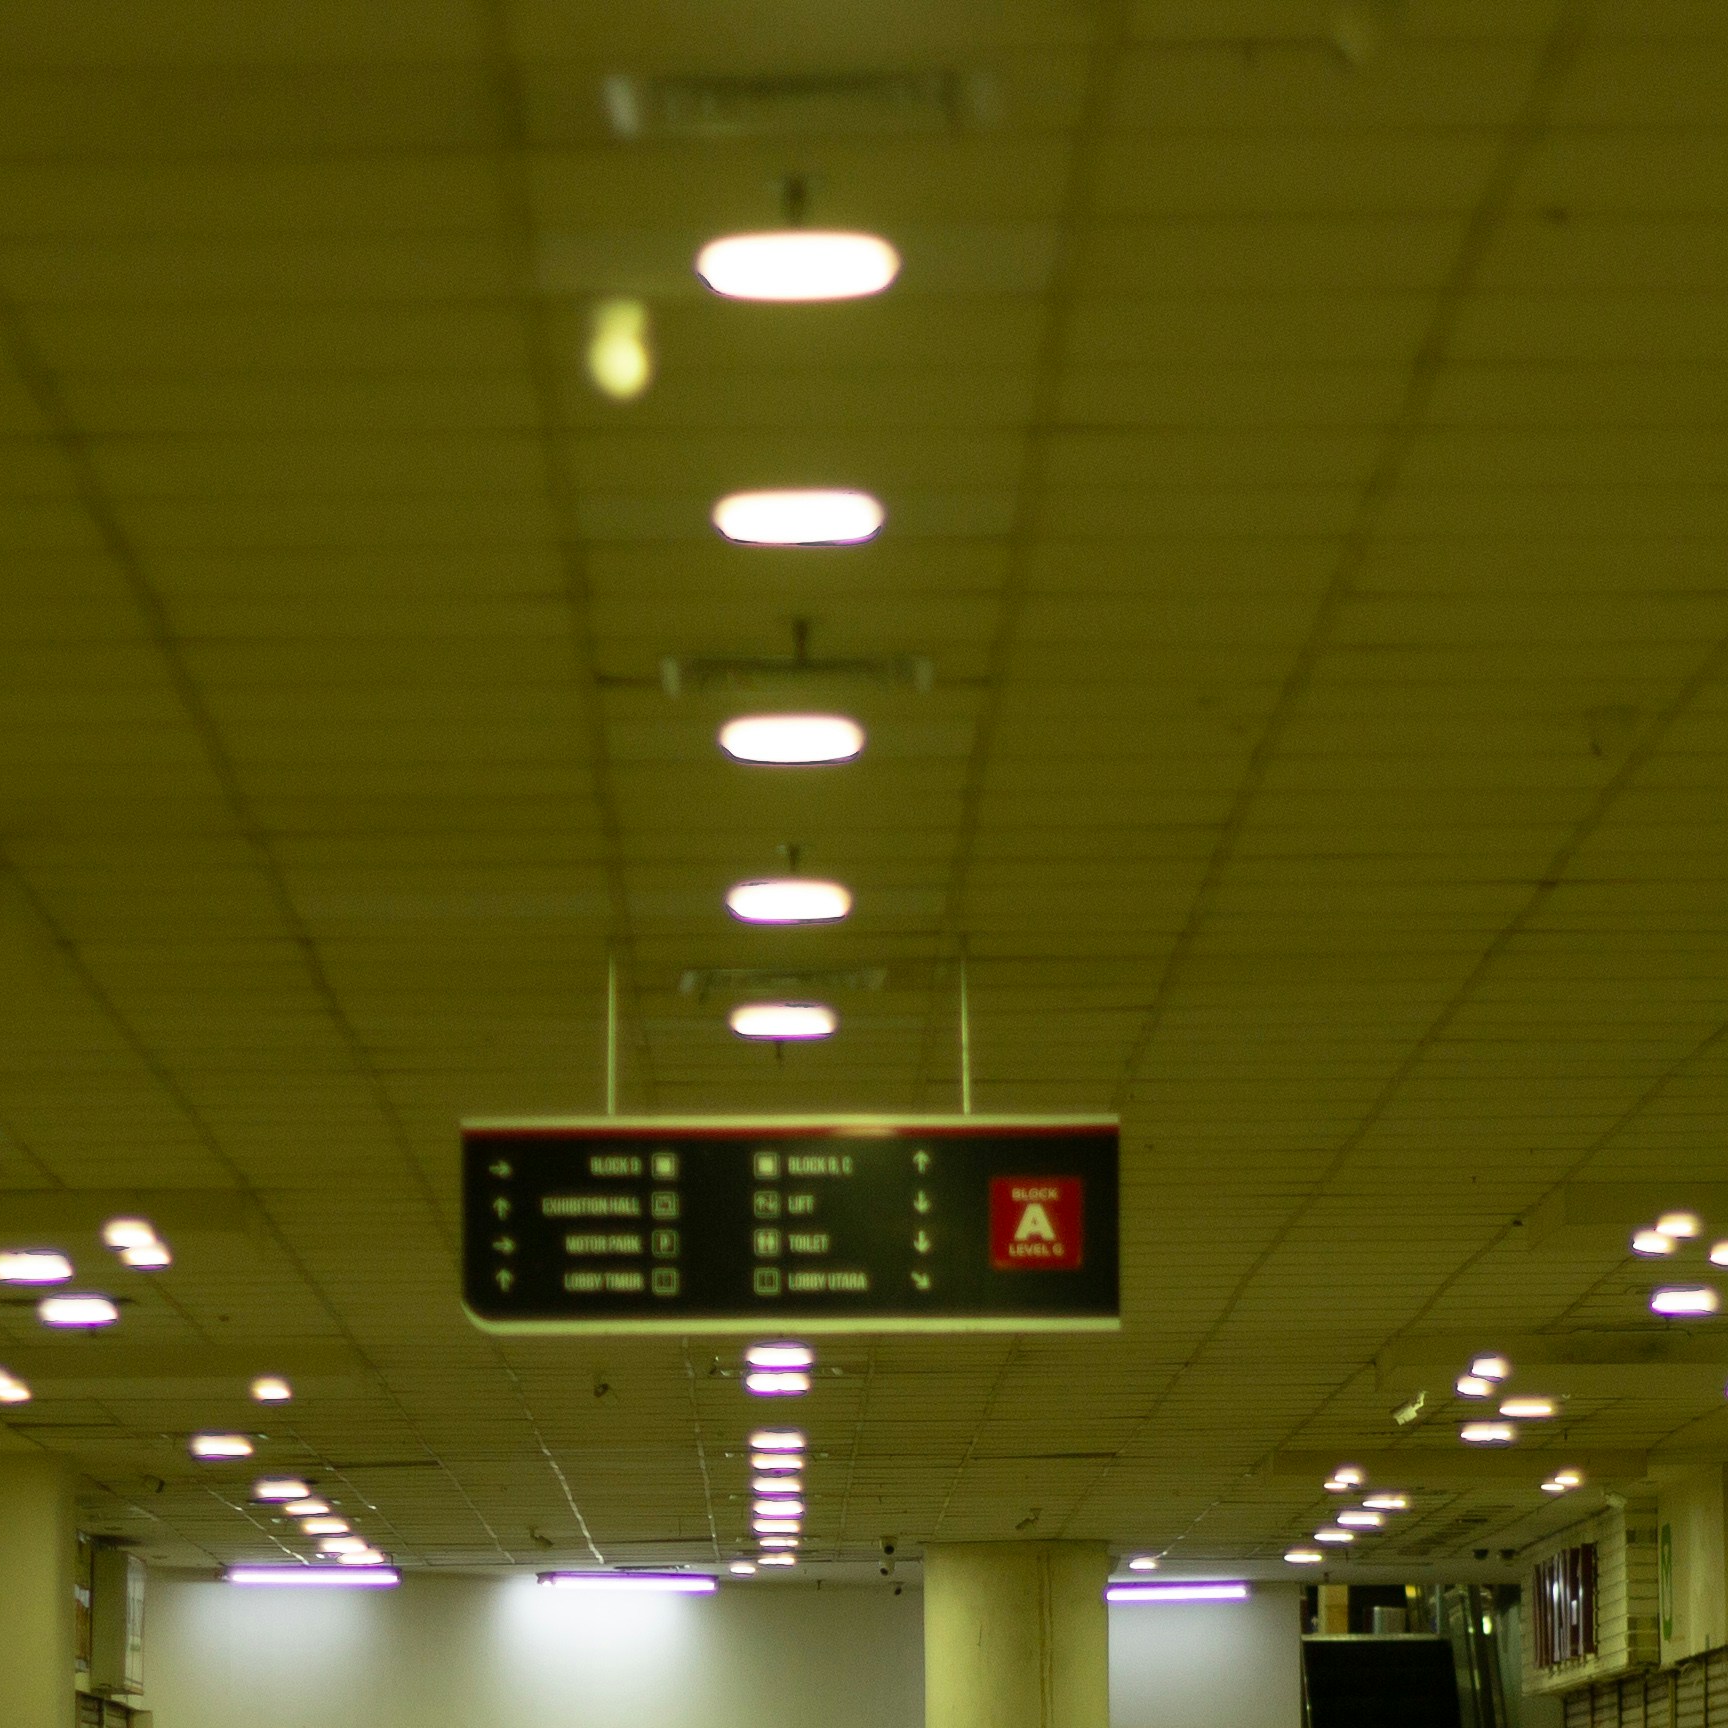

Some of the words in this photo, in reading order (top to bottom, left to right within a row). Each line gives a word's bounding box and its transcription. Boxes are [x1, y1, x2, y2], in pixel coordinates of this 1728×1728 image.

[589, 1155, 629, 1176] BLOCK
[788, 1156, 825, 1175] BLOCK
[1011, 1187, 1059, 1201] BLOCK
[541, 1196, 608, 1217] EXHIBITION
[609, 1197, 641, 1217] HALL
[788, 1195, 815, 1214] LIFT
[1014, 1202, 1055, 1241] A
[565, 1234, 606, 1254] MOTOR
[608, 1235, 642, 1254] PARK
[788, 1234, 830, 1253] TOILET
[1008, 1243, 1049, 1257] LEVEL
[564, 1272, 603, 1292] LOBBY
[605, 1273, 644, 1292] TIMUR
[788, 1272, 827, 1291] LOBBY
[828, 1272, 868, 1292] UTARA
